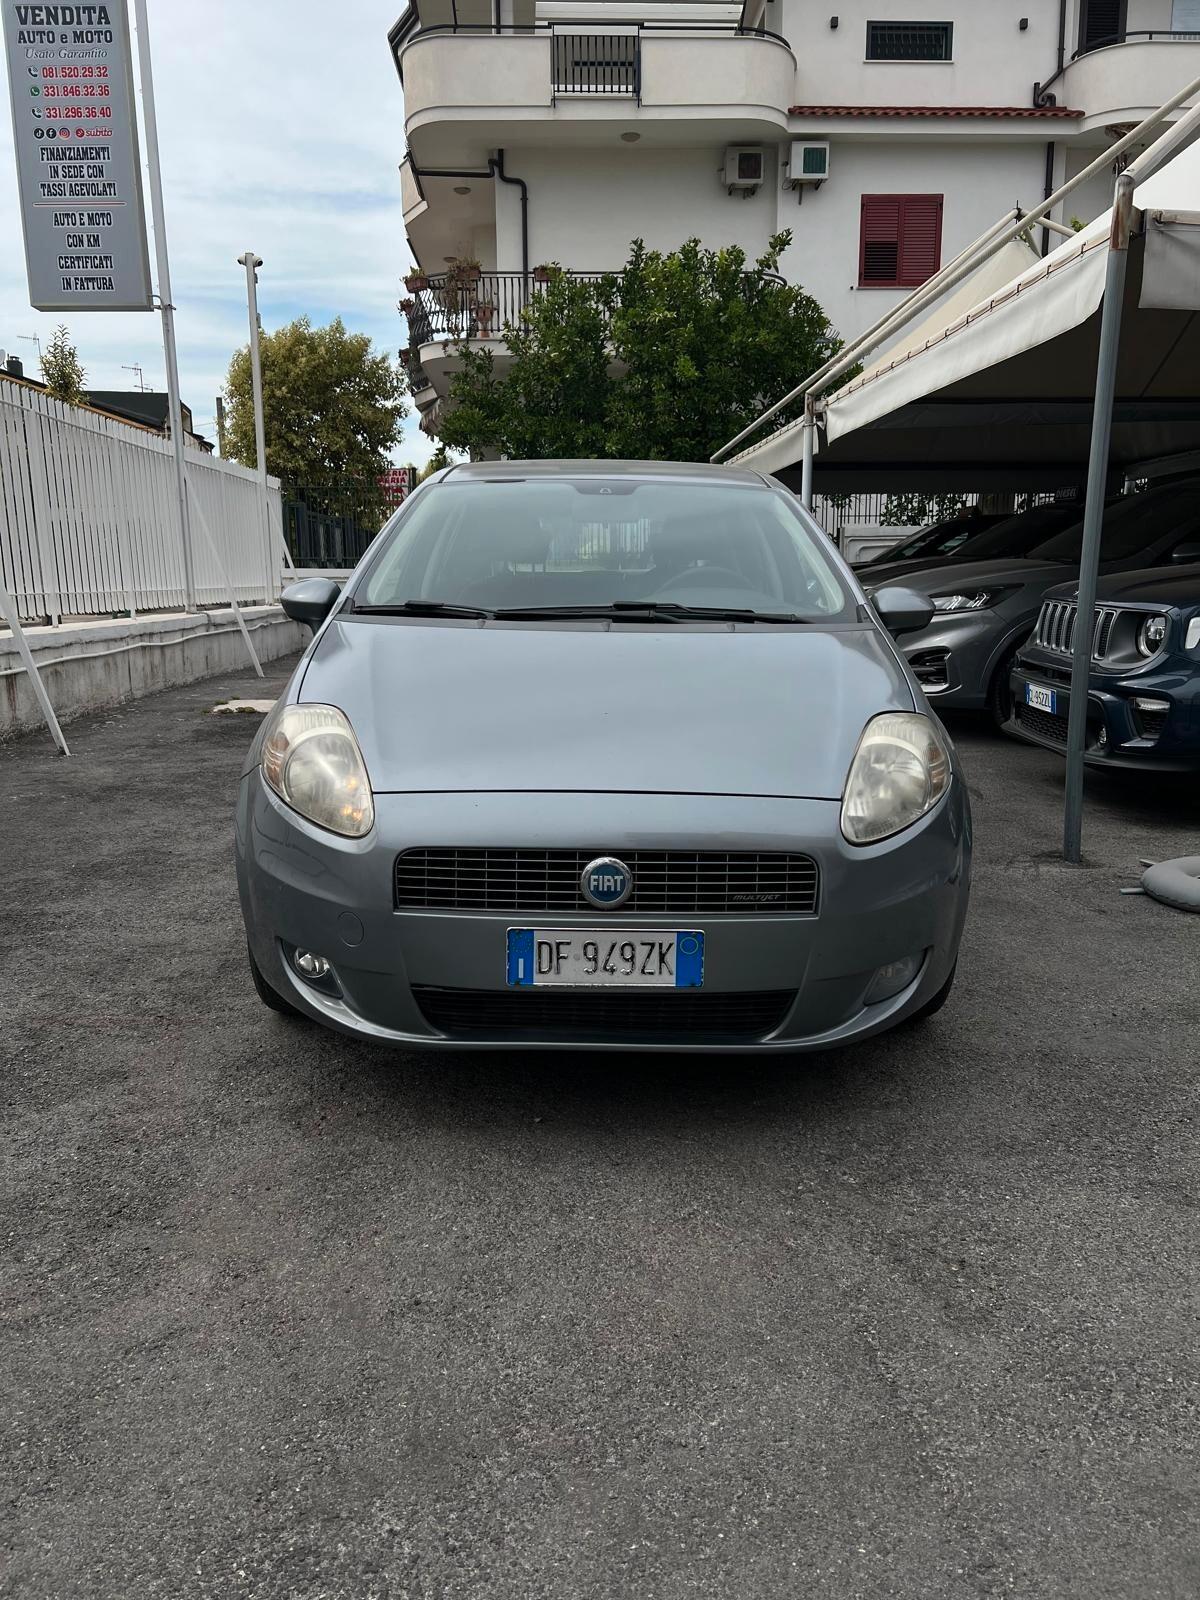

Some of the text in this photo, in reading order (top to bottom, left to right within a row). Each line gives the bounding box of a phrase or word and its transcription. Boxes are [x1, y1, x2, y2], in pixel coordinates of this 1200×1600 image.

[16, 6, 110, 26] VENDITA
[18, 30, 113, 44] AUTO e MOTO
[26, 48, 108, 59] Usato Garantito
[42, 66, 108, 78] 081.520.29.32
[43, 85, 110, 97] 331.846.32.36
[45, 106, 111, 118] 331.296.36.40
[86, 128, 112, 137] subito
[40, 146, 110, 161] FINANZIAMENTI
[49, 164, 104, 178] IN SEDE CON
[40, 182, 116, 197] TASSI AGEVOLATI
[53, 212, 112, 226] AUTO E MOTO
[66, 234, 100, 248] CON KM
[58, 256, 114, 270] CERTIFICATI
[62, 276, 114, 291] IN FATTURA
[589, 874, 624, 892] FIAT
